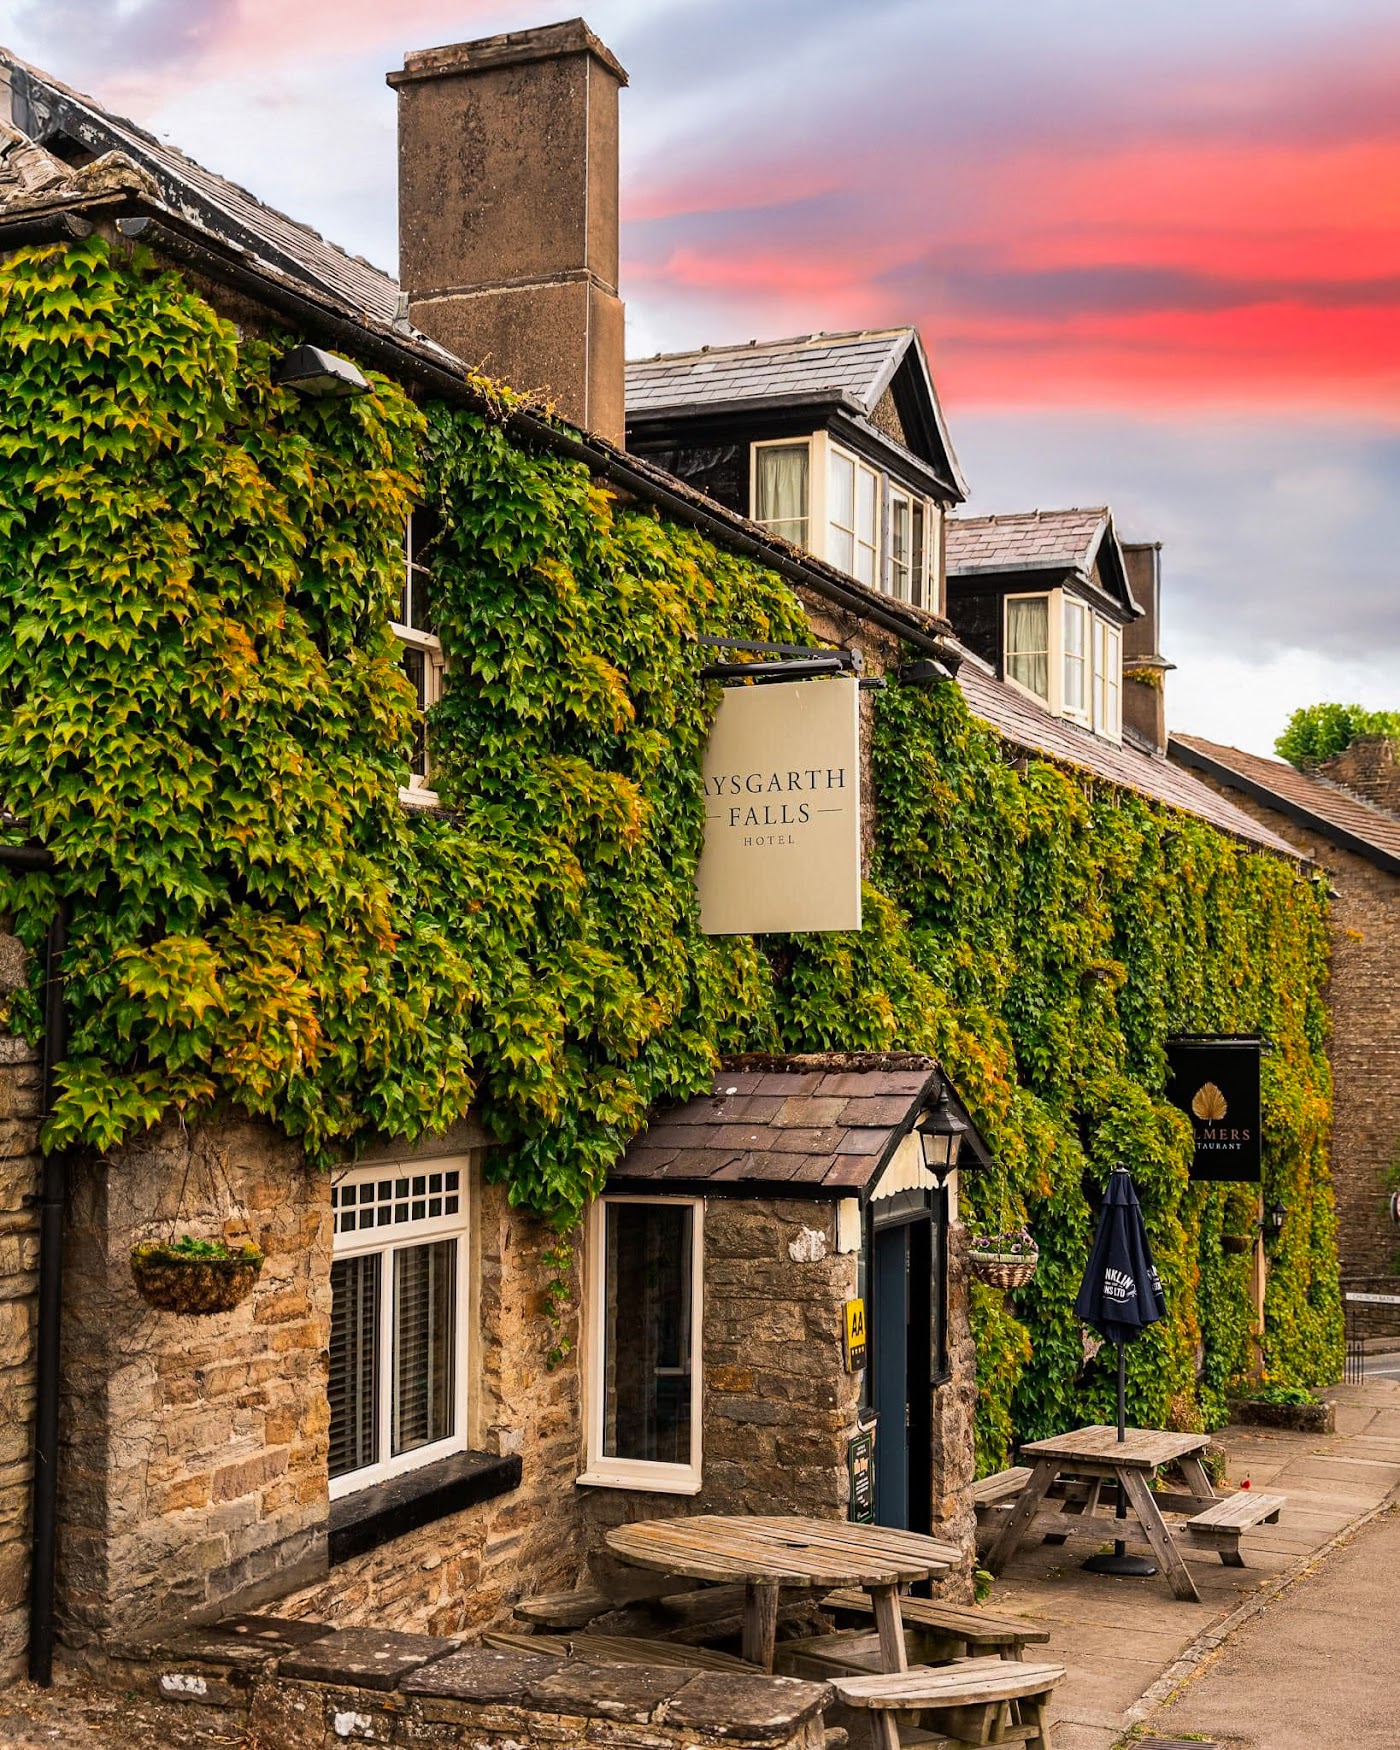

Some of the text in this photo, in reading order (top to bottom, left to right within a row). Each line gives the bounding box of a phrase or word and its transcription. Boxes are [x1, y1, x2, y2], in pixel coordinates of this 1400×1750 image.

[728, 803, 810, 827] FALLS
[744, 834, 795, 847] HOTEL
[1193, 1128, 1250, 1141] LMERS
[1196, 1142, 1242, 1150] TAURANT
[1105, 1267, 1133, 1290] NKLIN
[1113, 1286, 1126, 1298] LTD
[851, 1311, 864, 1338] AA
